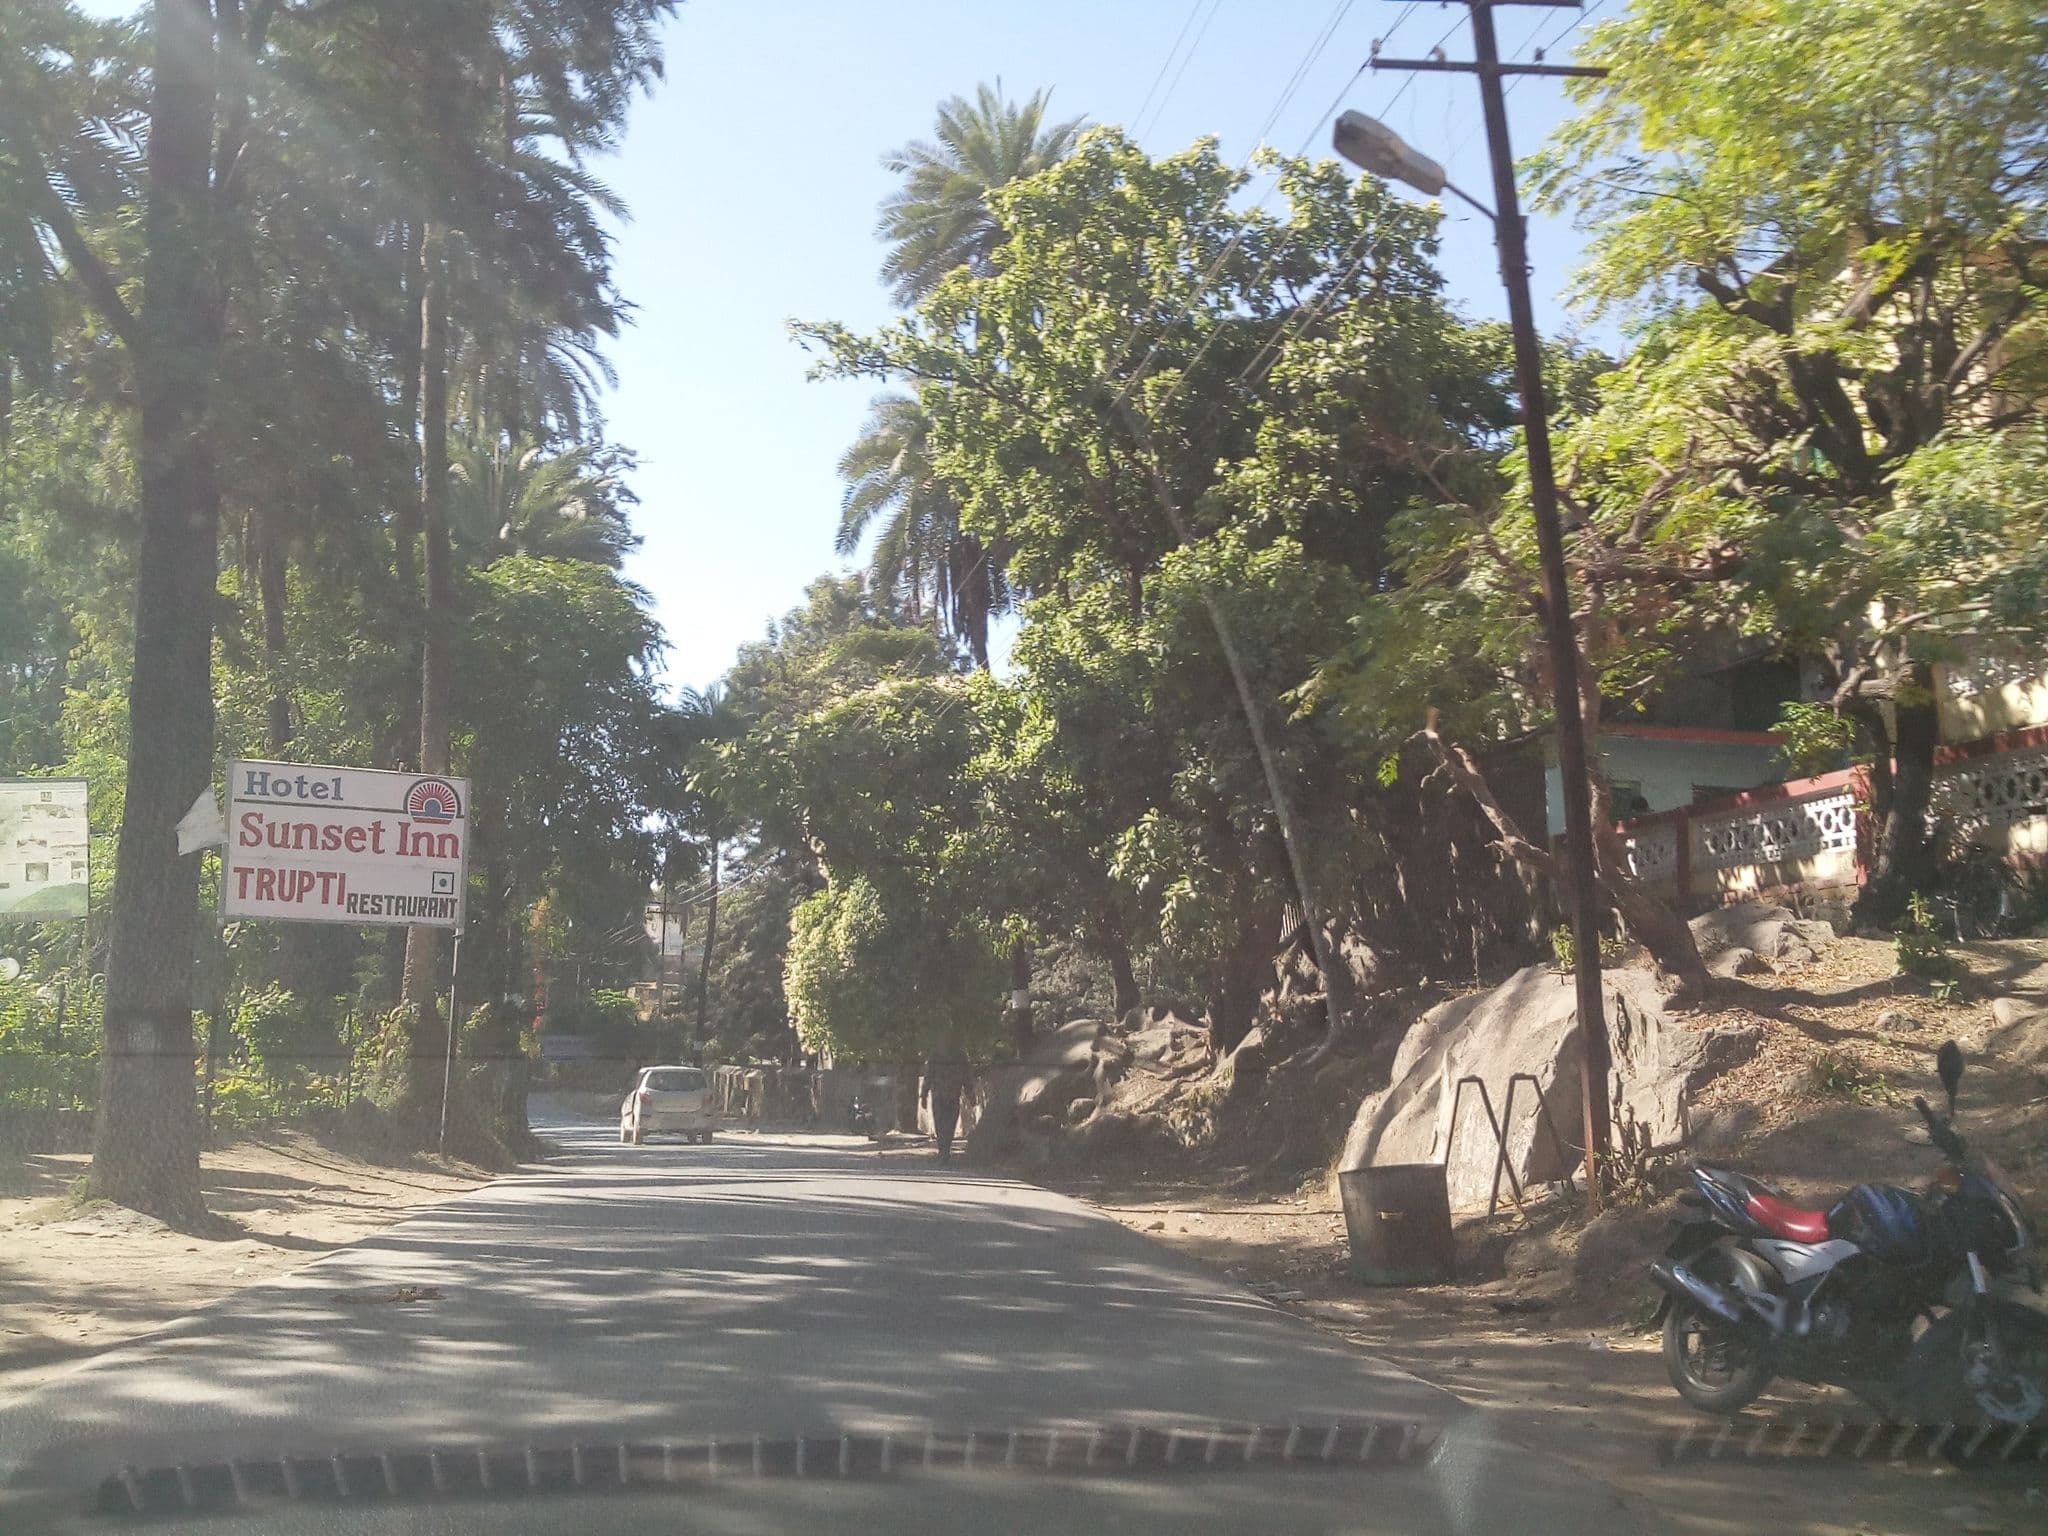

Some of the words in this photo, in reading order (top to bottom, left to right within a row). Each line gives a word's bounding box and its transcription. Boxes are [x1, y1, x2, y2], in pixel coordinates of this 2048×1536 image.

[244, 771, 344, 801] Hotel
[239, 812, 386, 854] Sunset
[395, 821, 460, 859] Inn
[233, 866, 346, 905] TRUPTI
[346, 892, 458, 919] RESTAURANT
